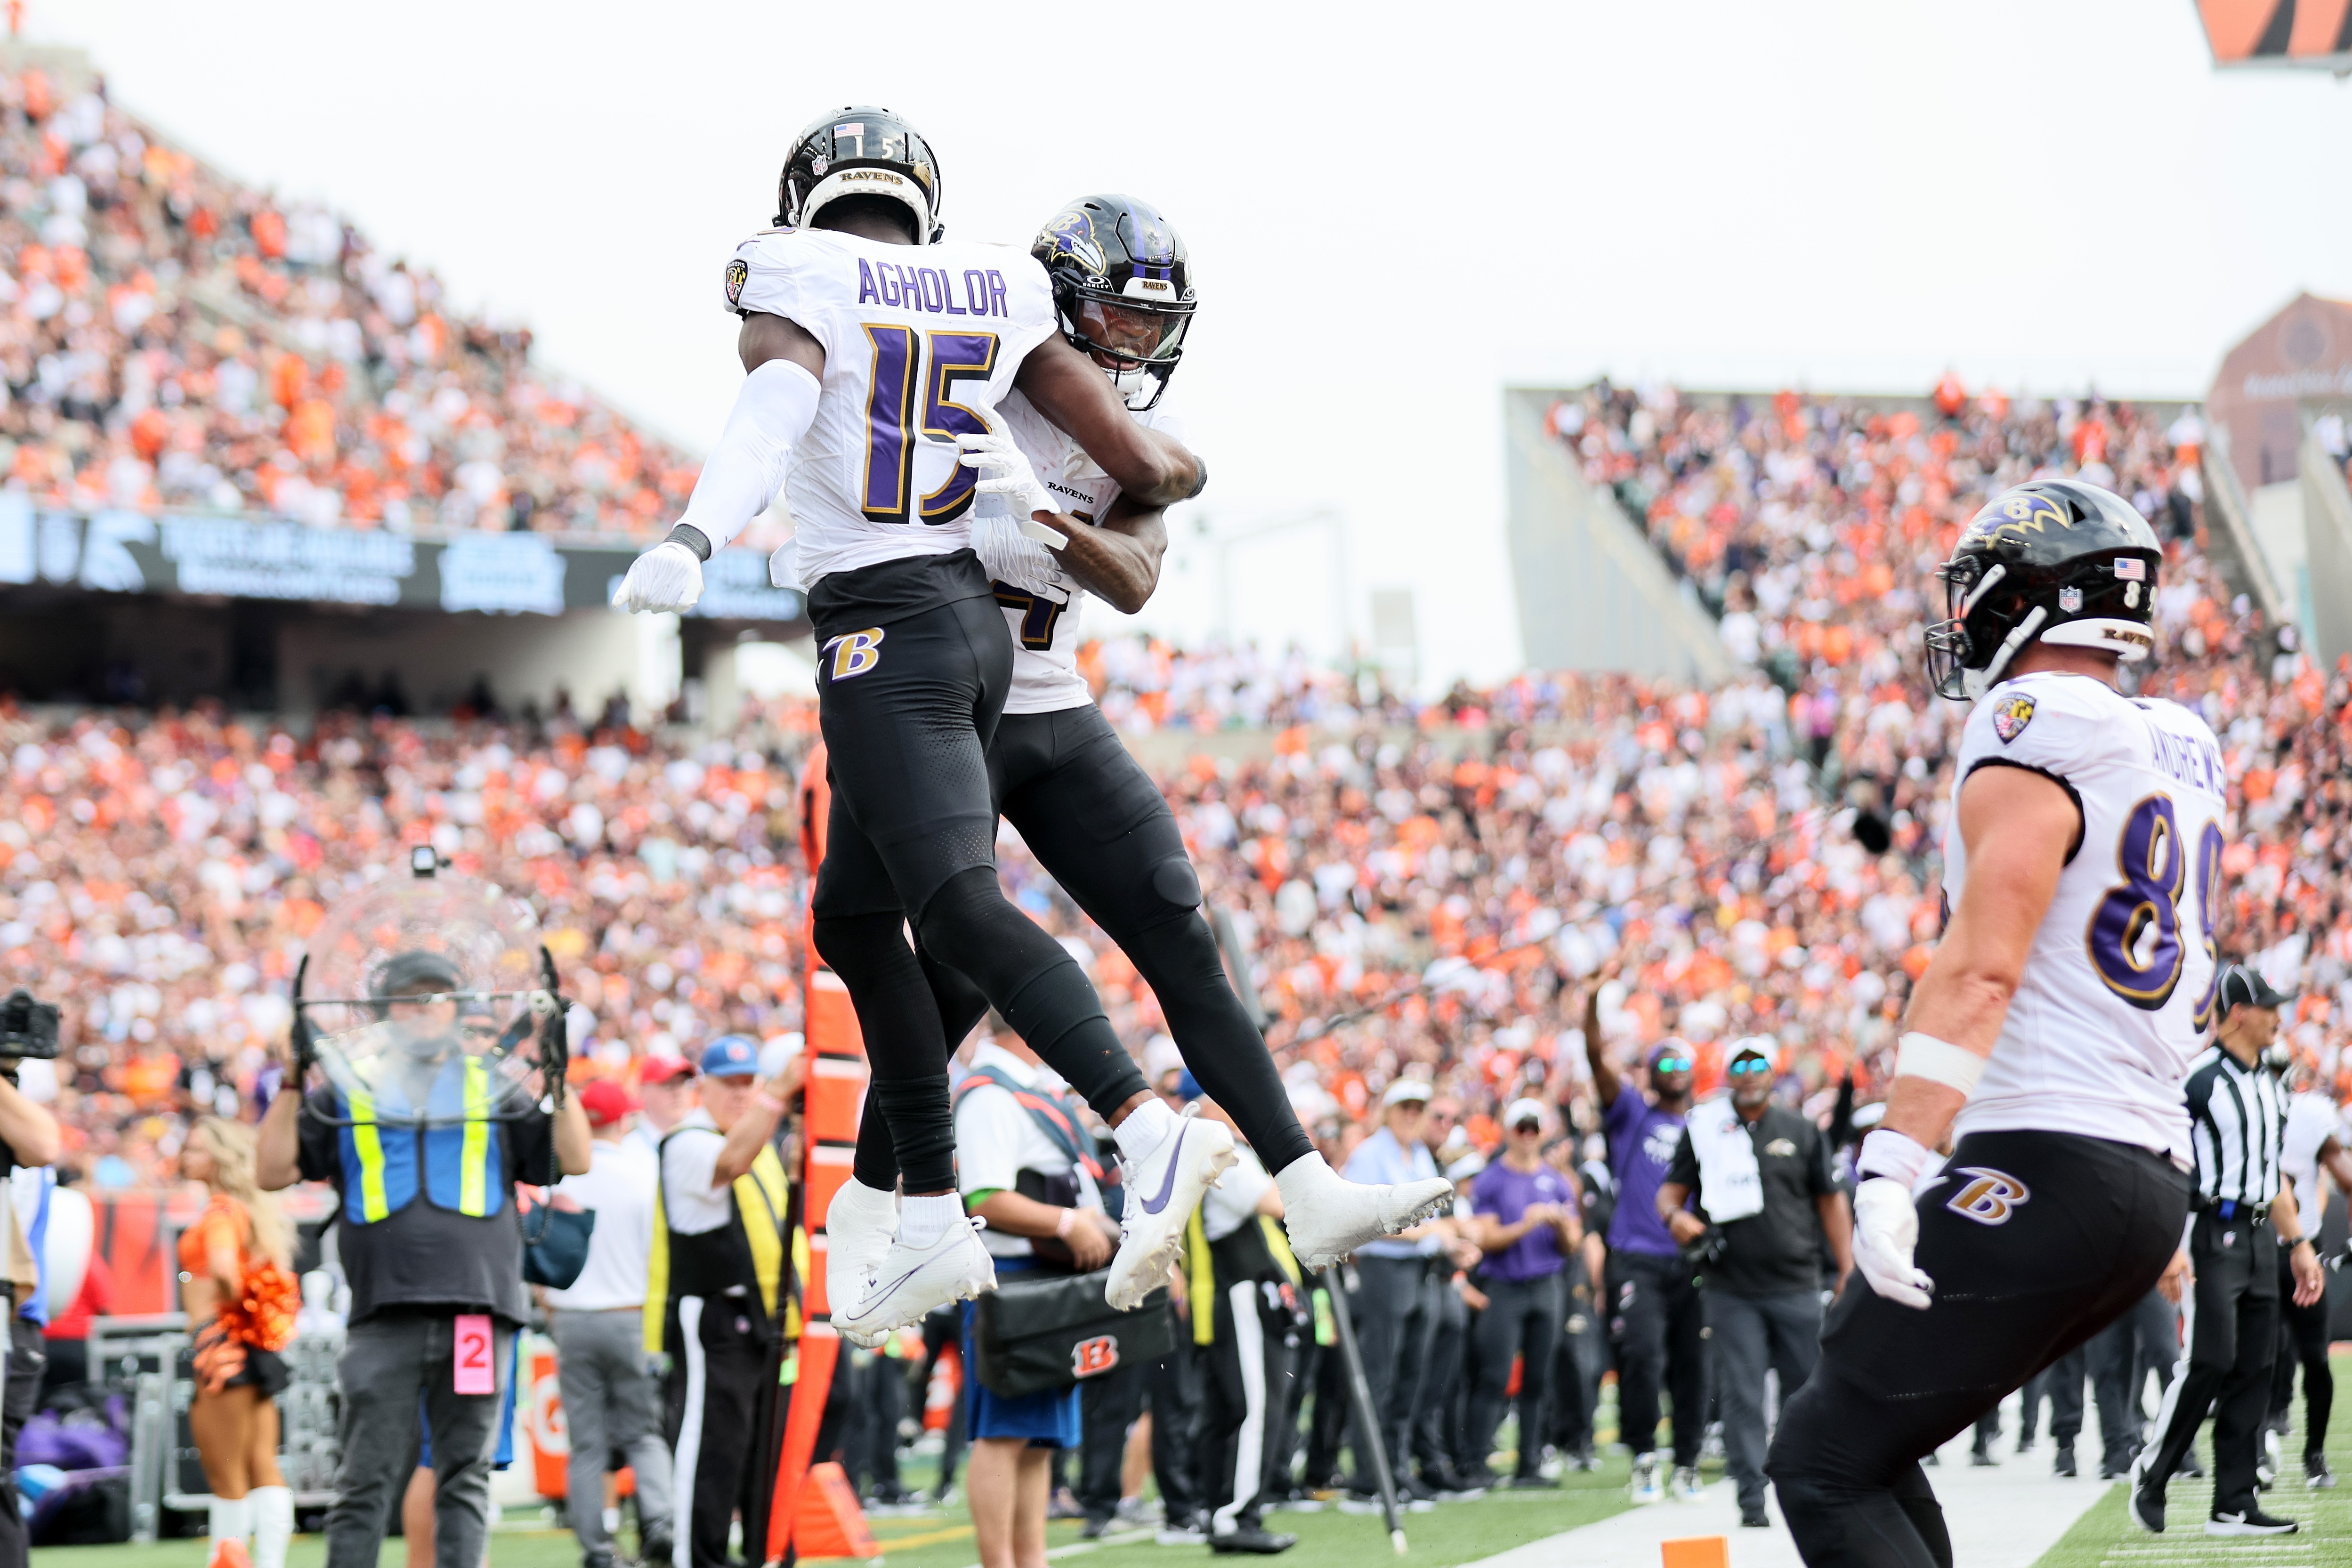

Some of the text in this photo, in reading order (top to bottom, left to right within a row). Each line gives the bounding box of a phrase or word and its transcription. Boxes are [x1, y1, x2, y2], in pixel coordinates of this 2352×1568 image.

[854, 136, 894, 159] 15
[815, 161, 826, 172] NFL
[839, 171, 903, 186] RAVENS
[858, 258, 1008, 318] AGHOLOR
[1142, 281, 1167, 291] RAVENS
[861, 322, 1001, 526] 15
[1048, 482, 1094, 504] RAVENS
[1999, 497, 2033, 520] B
[2062, 598, 2077, 607] NFL
[2124, 580, 2158, 612] 89
[822, 627, 885, 681] B
[2086, 791, 2224, 1035] 89
[1946, 1166, 2031, 1226] B
[462, 1332, 486, 1368] 2
[1070, 1334, 1120, 1379] B
